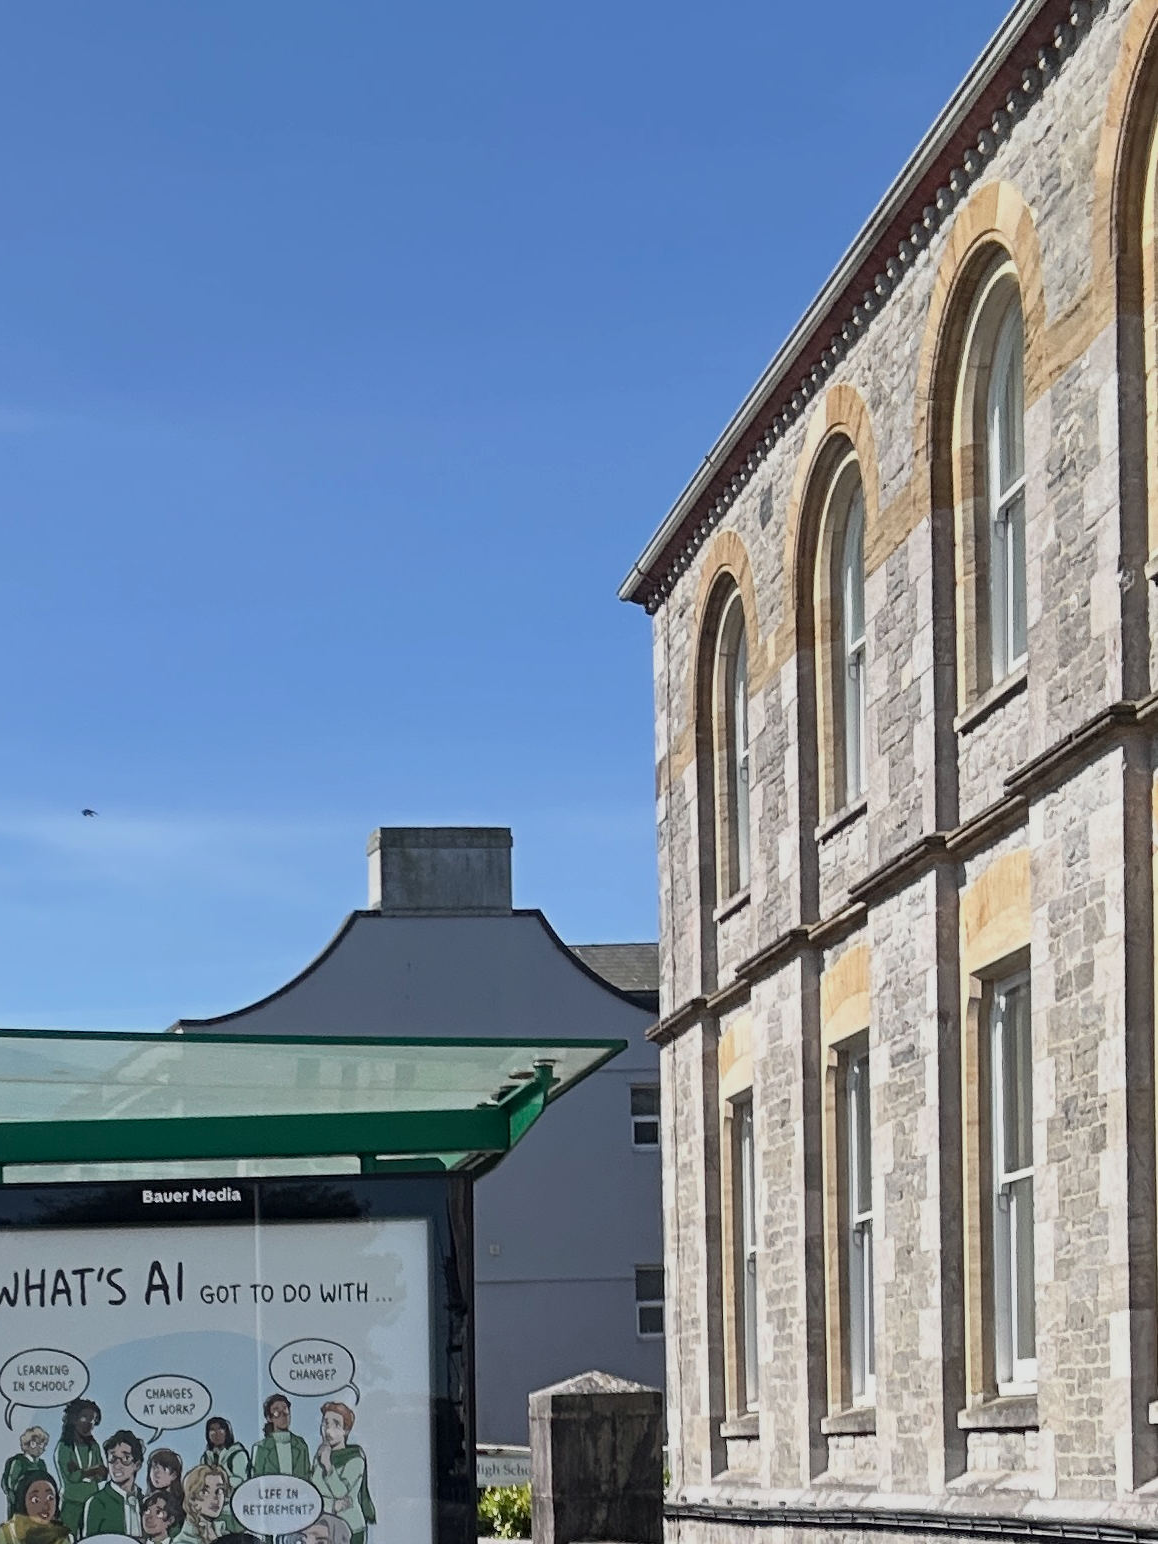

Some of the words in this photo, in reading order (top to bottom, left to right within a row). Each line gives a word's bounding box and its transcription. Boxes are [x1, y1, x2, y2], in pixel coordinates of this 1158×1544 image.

[142, 1189, 190, 1204] Bauer
[192, 1186, 242, 1203] Media
[144, 1260, 184, 1306] AI
[199, 1283, 242, 1305] GOT
[249, 1283, 275, 1304] TO
[282, 1283, 312, 1304] DO
[291, 1352, 334, 1365] CLIMATE
[16, 1364, 70, 1377] LEARNING
[288, 1368, 337, 1381] CHANGE?
[12, 1380, 26, 1392] IN
[28, 1379, 75, 1393] SCHOOL?
[145, 1387, 194, 1400] CHANGES
[143, 1403, 156, 1416] AT
[158, 1402, 196, 1416] WORK?
[257, 1488, 282, 1500] LIFE
[286, 1487, 299, 1500] IN
[242, 1503, 315, 1516] RETIREMENT?
